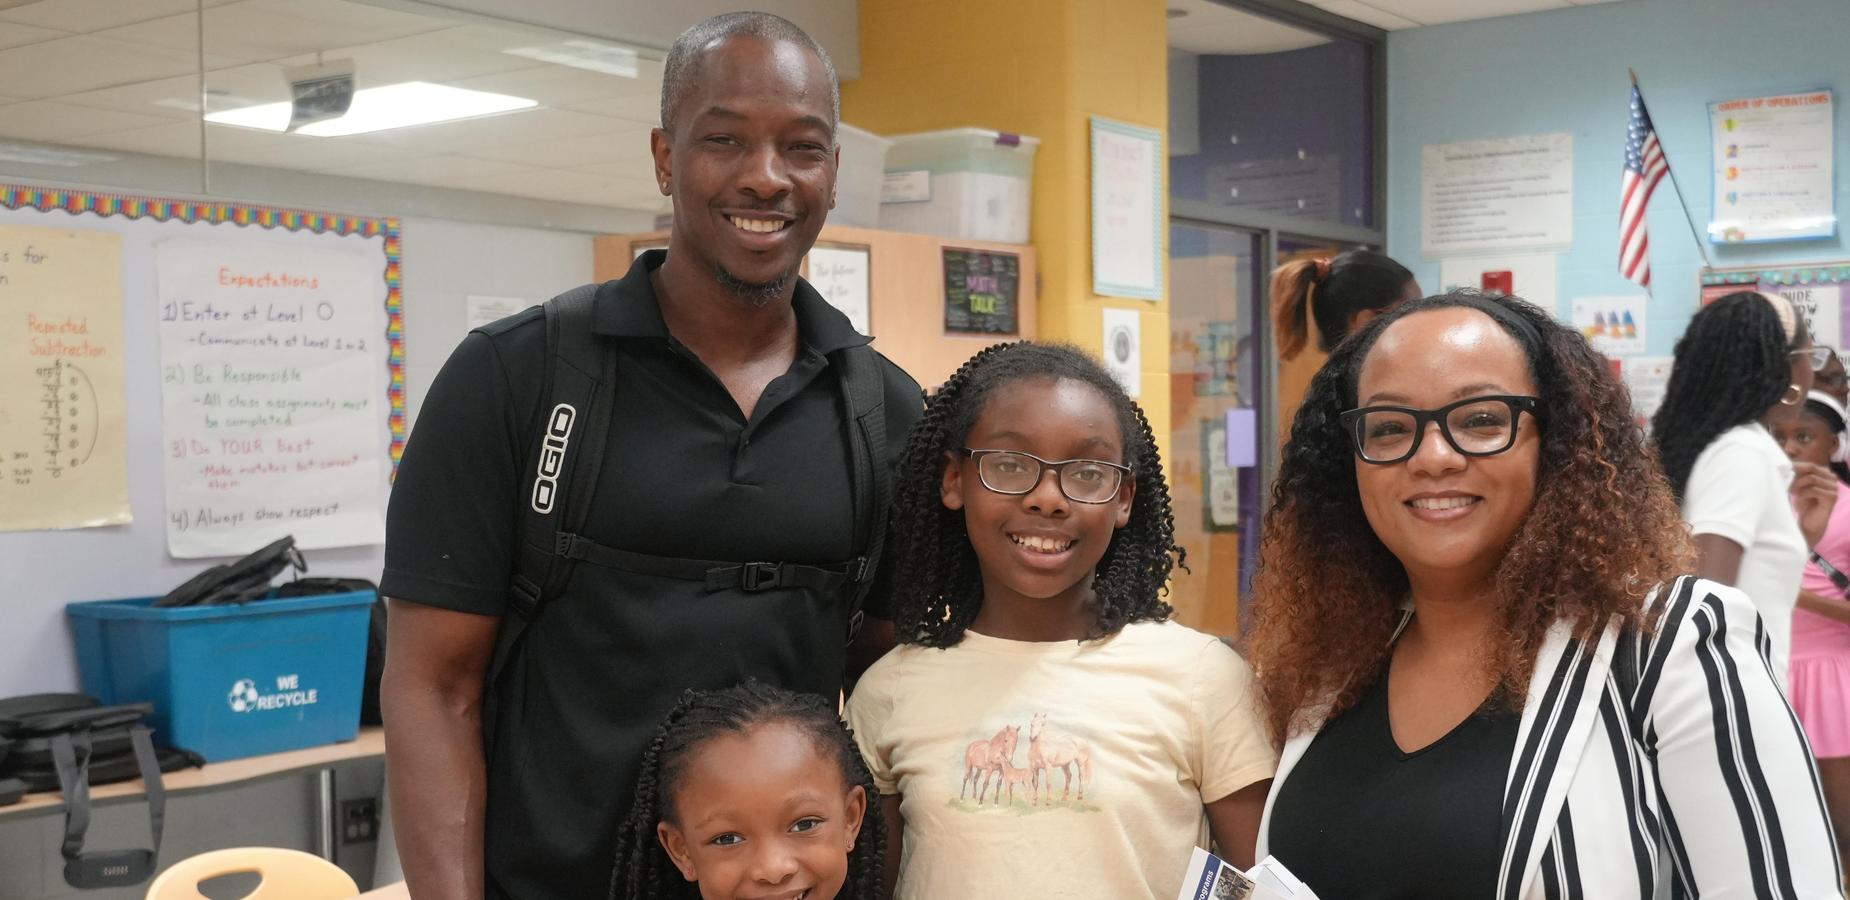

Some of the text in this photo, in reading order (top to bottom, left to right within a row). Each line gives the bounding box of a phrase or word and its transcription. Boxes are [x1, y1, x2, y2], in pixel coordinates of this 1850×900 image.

[24, 245, 48, 264] for
[219, 266, 319, 289] Expectations
[183, 301, 231, 322] Enter
[243, 304, 258, 321] at
[267, 302, 304, 322] Level
[969, 293, 998, 315] TALK
[28, 312, 88, 335] Repeated
[30, 336, 106, 356] Subtraction
[285, 335, 298, 347] at
[304, 335, 330, 349] Level
[357, 338, 367, 352] 2
[193, 363, 213, 384] Be
[224, 363, 303, 384] Responsible
[342, 397, 369, 411] must
[206, 414, 293, 429] be completed
[220, 438, 264, 455] YOUR
[277, 437, 315, 454] best
[531, 403, 577, 515] OGIO
[171, 502, 339, 532] 4) Always show respect
[276, 674, 298, 691] WE
[257, 689, 318, 710] RECYCLE
